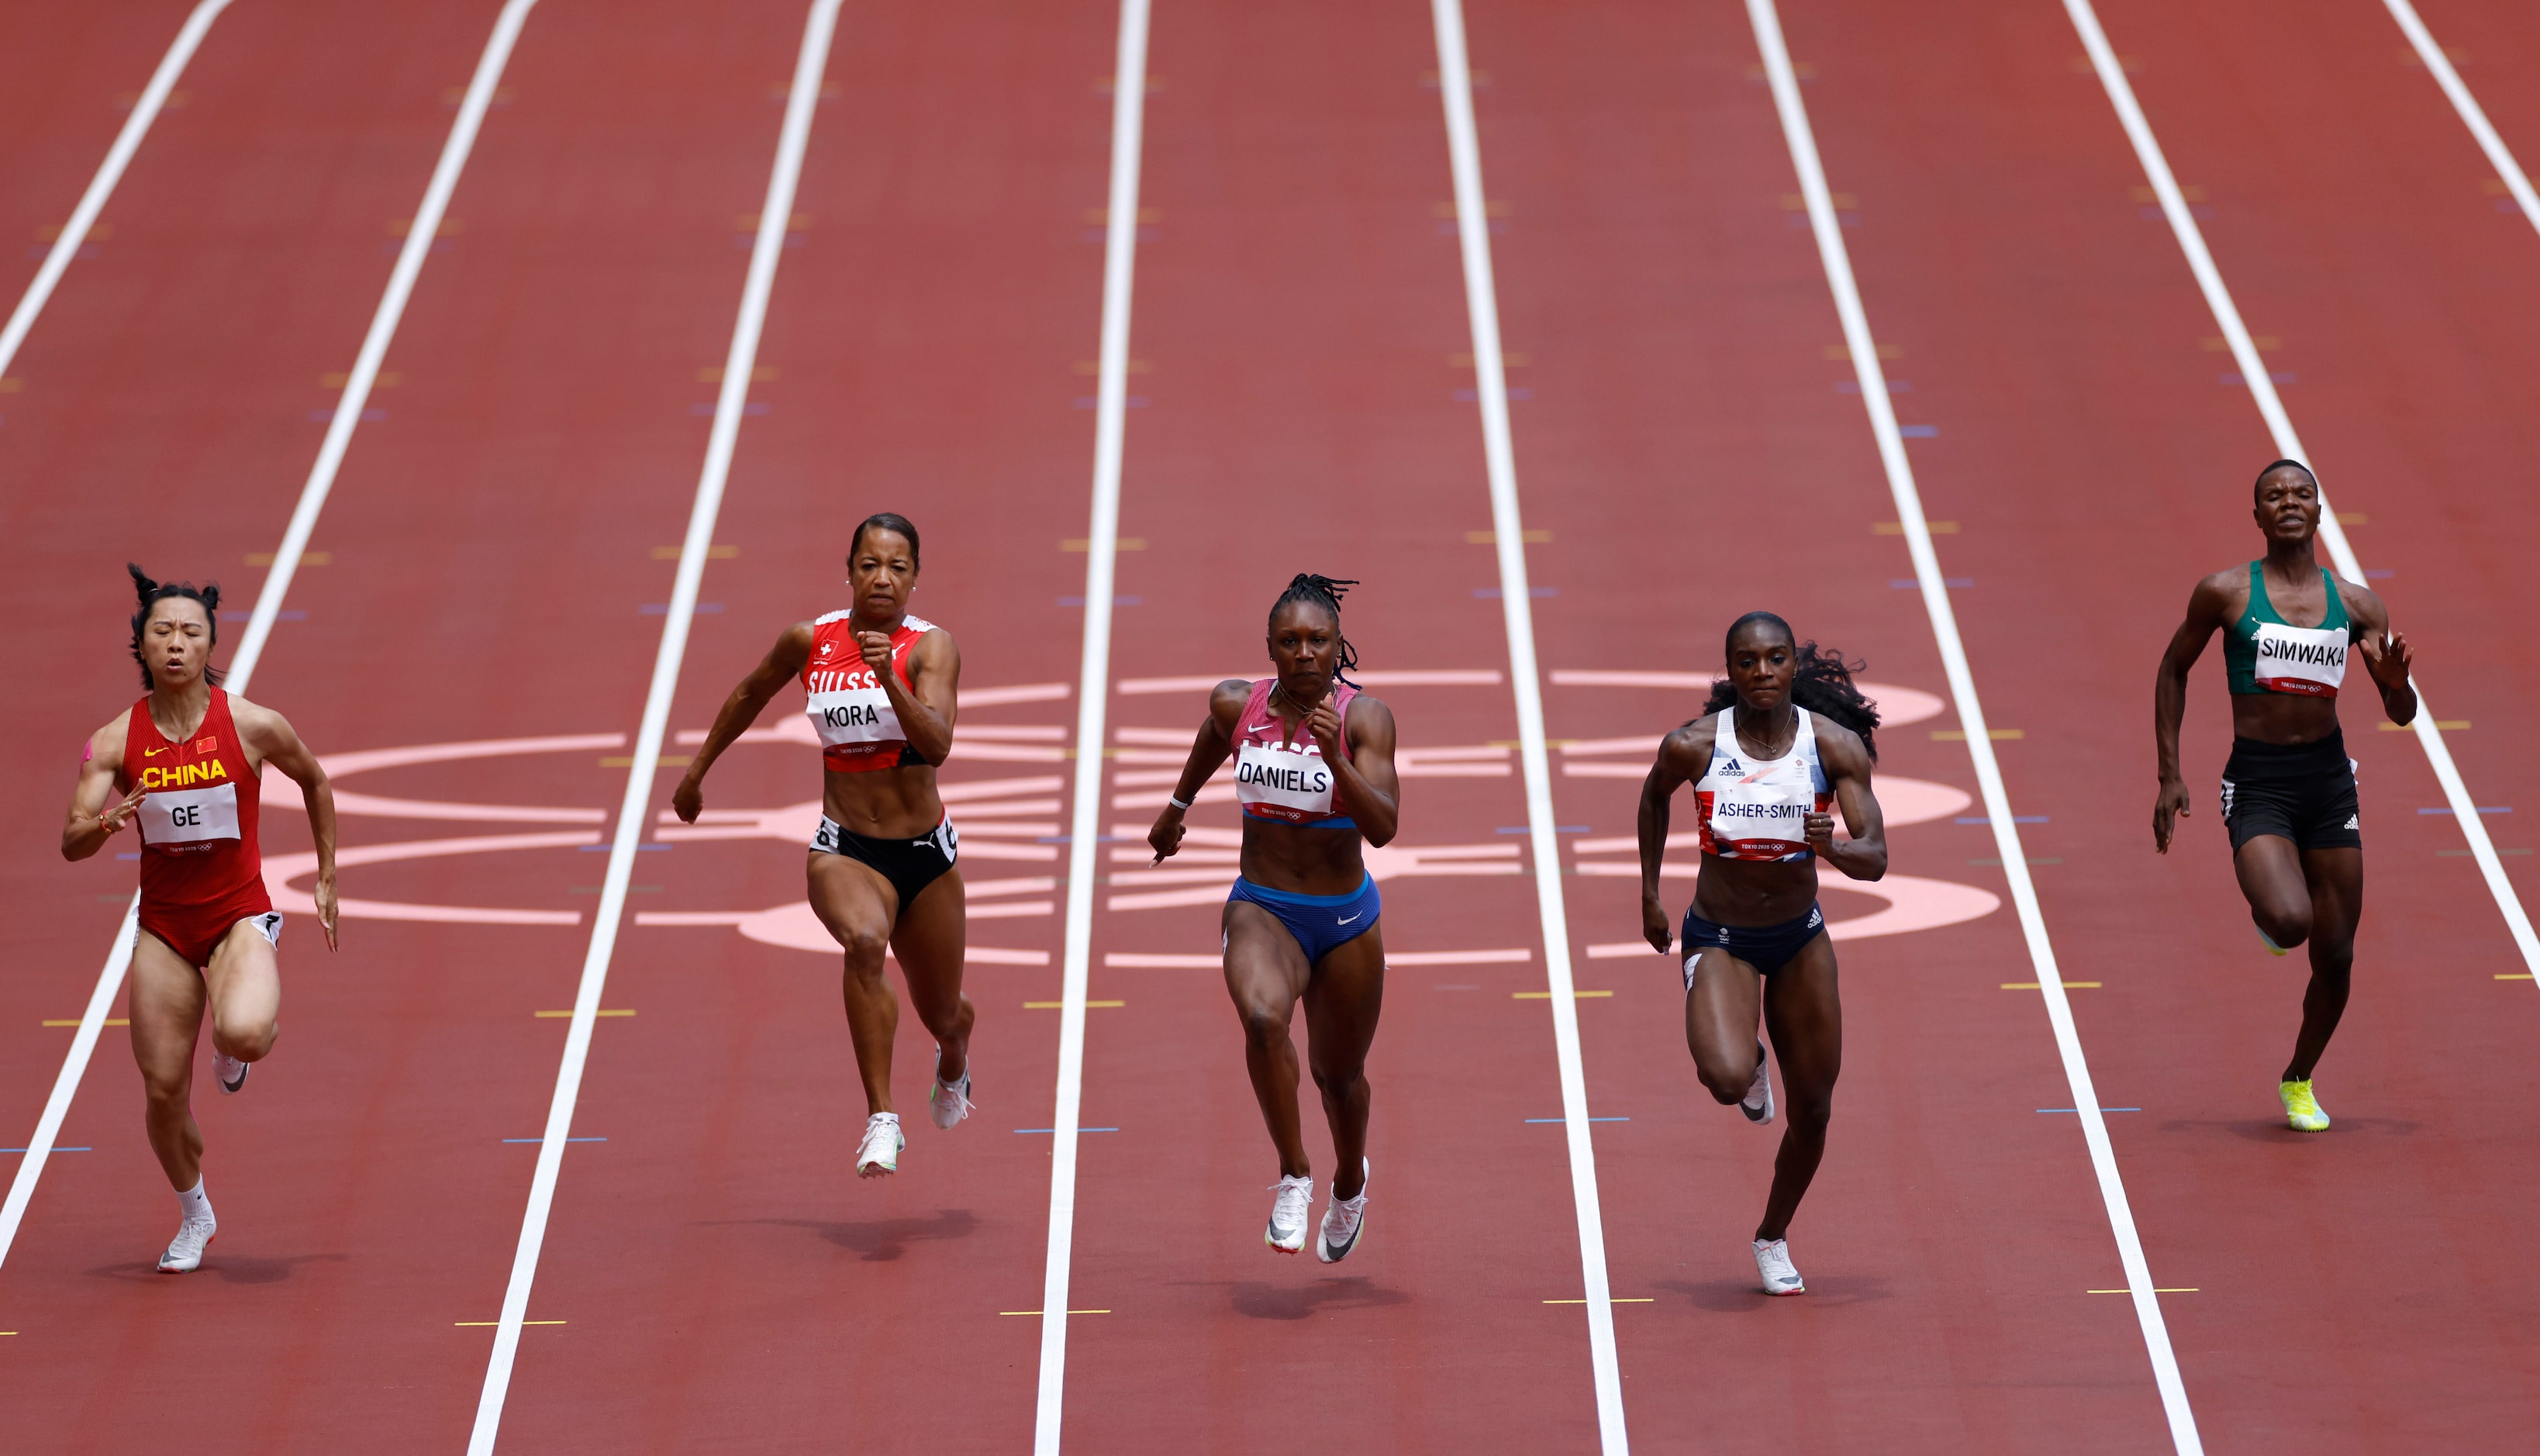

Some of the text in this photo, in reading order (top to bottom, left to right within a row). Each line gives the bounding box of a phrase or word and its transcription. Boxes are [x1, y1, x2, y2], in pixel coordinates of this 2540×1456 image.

[2262, 637, 2344, 667] SIMWAKA
[824, 704, 879, 728] KORA
[143, 759, 227, 788] CHINA
[1239, 762, 1327, 793] DANIELS
[172, 805, 201, 827] GE
[1718, 802, 1811, 819] ASHER-SMITH
